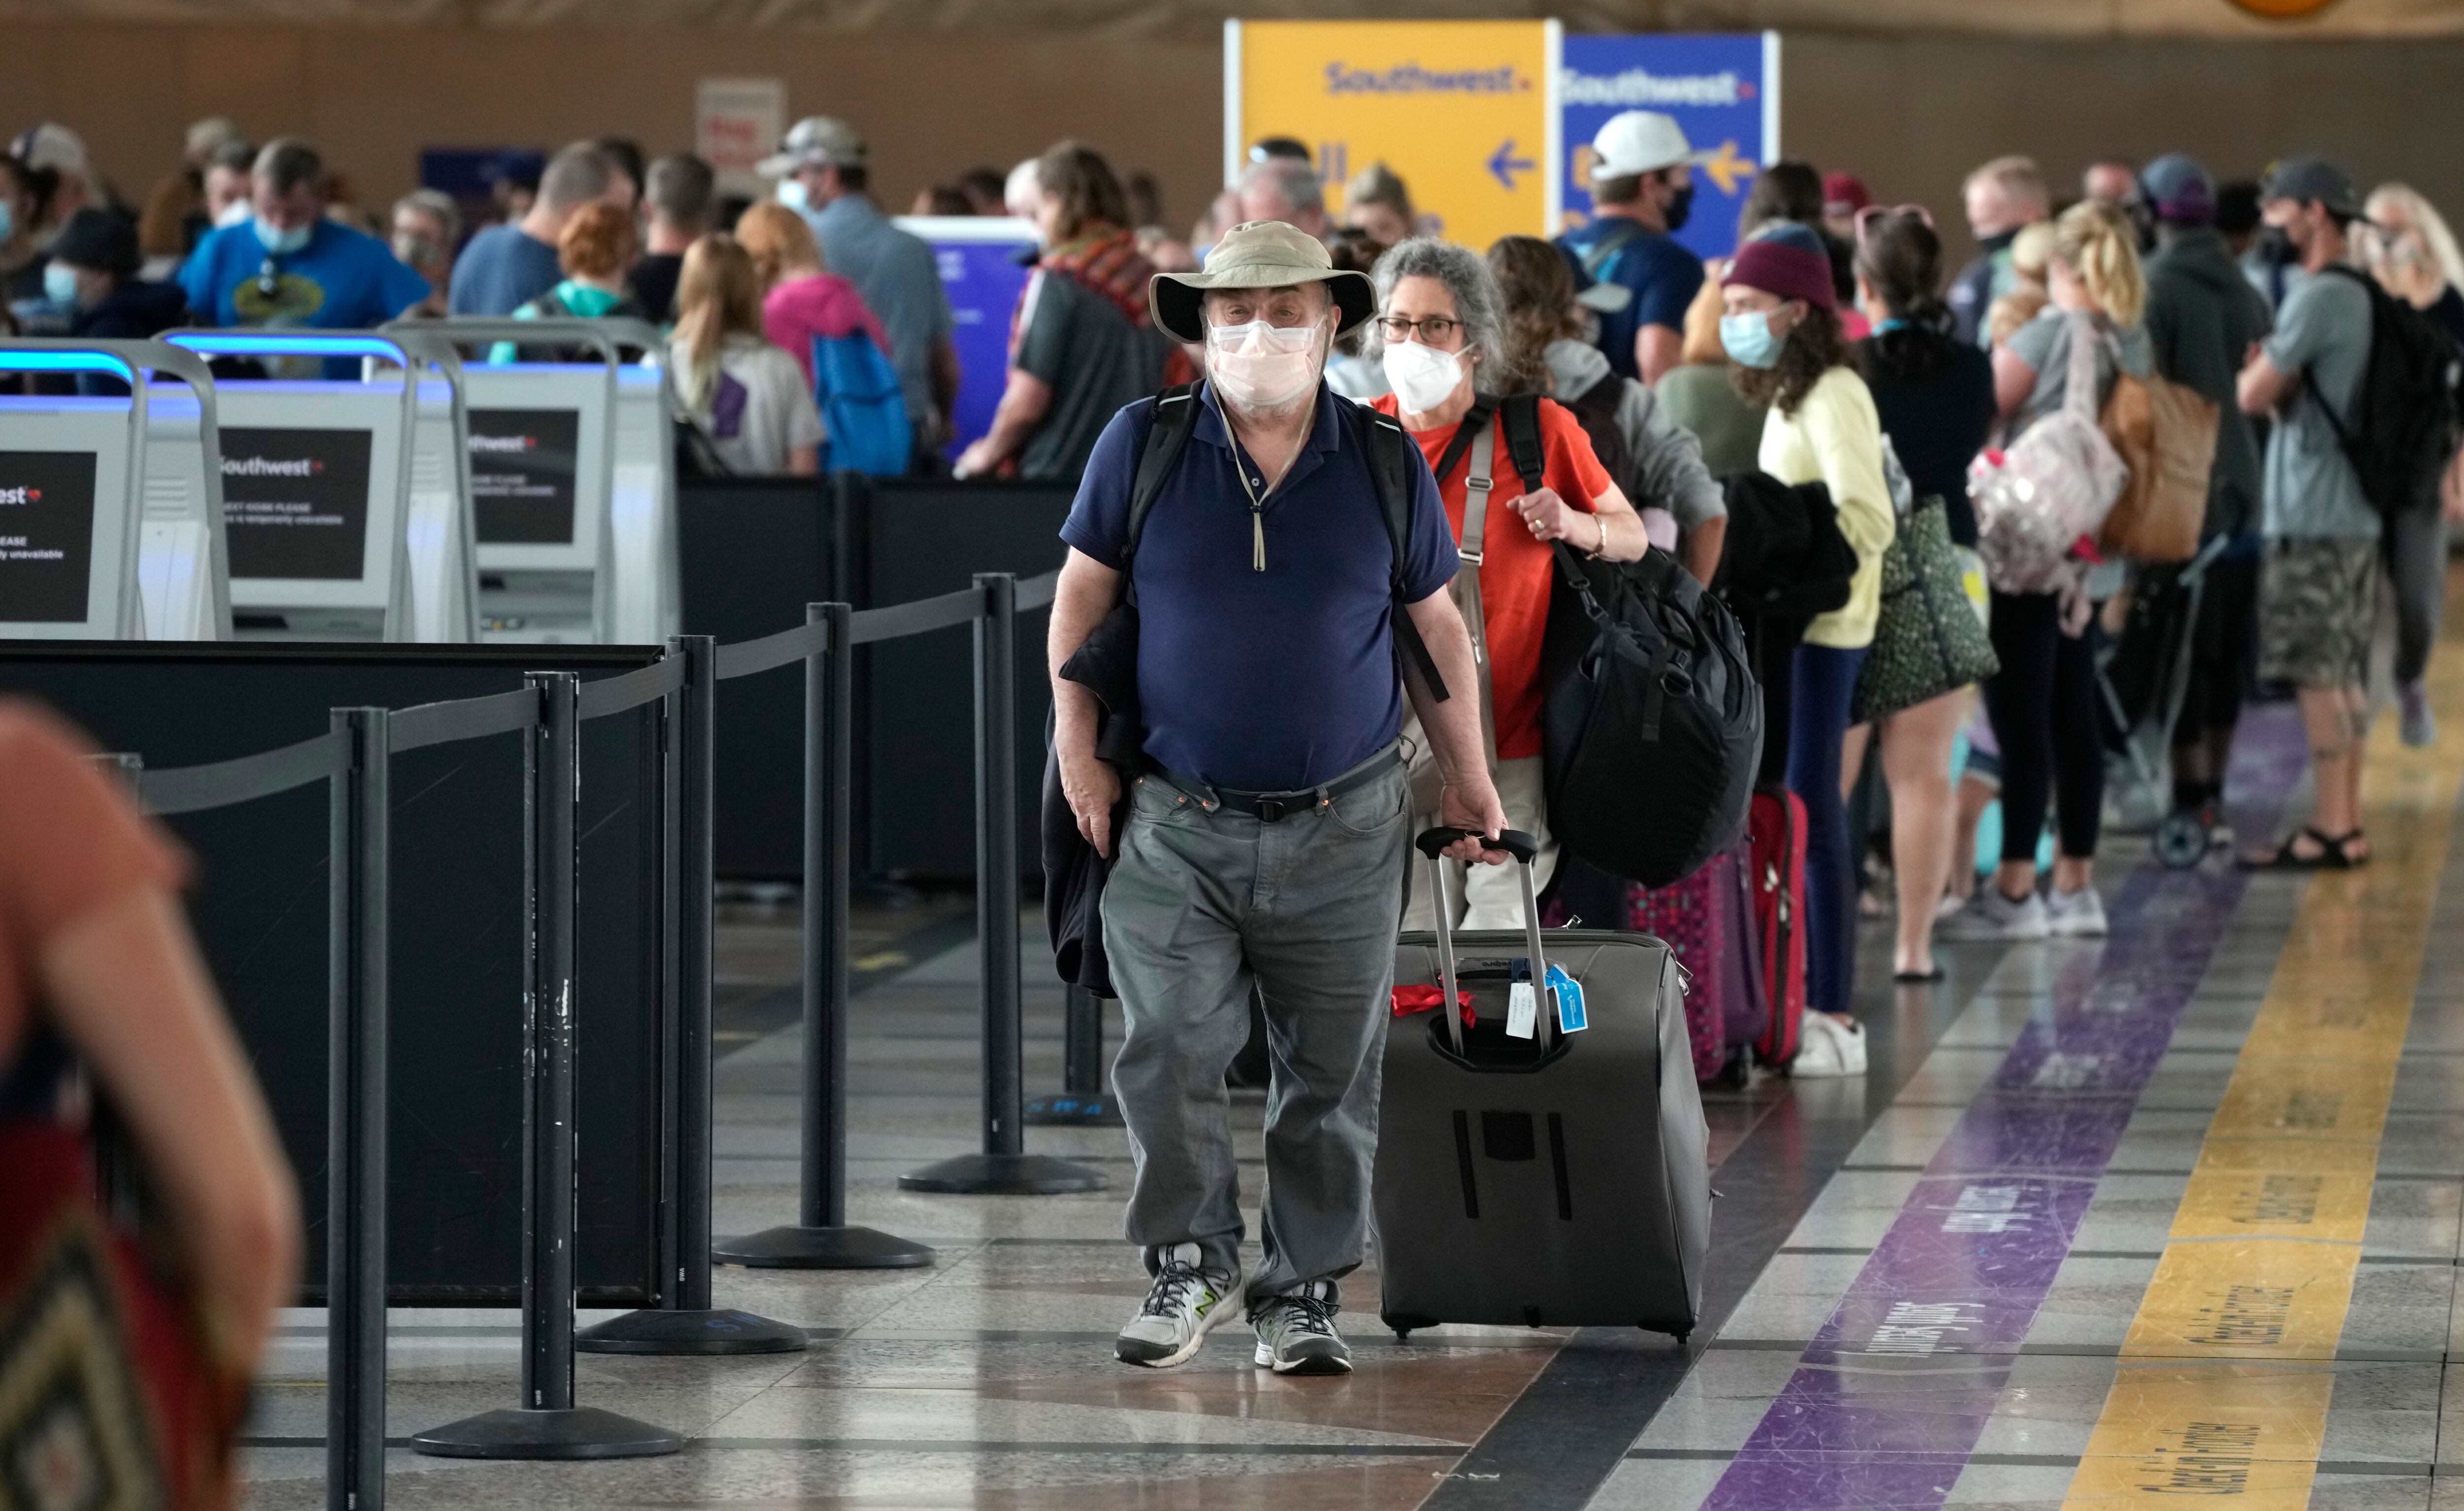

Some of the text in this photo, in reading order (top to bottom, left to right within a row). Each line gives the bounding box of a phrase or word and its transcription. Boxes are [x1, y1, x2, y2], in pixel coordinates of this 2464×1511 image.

[1325, 59, 1514, 94] Southwest
[0, 536, 27, 547] EASE
[9, 549, 64, 560] unavailable
[1832, 1302, 1986, 1359] South Security
[2134, 1421, 2260, 1495] Check-in Frontier
